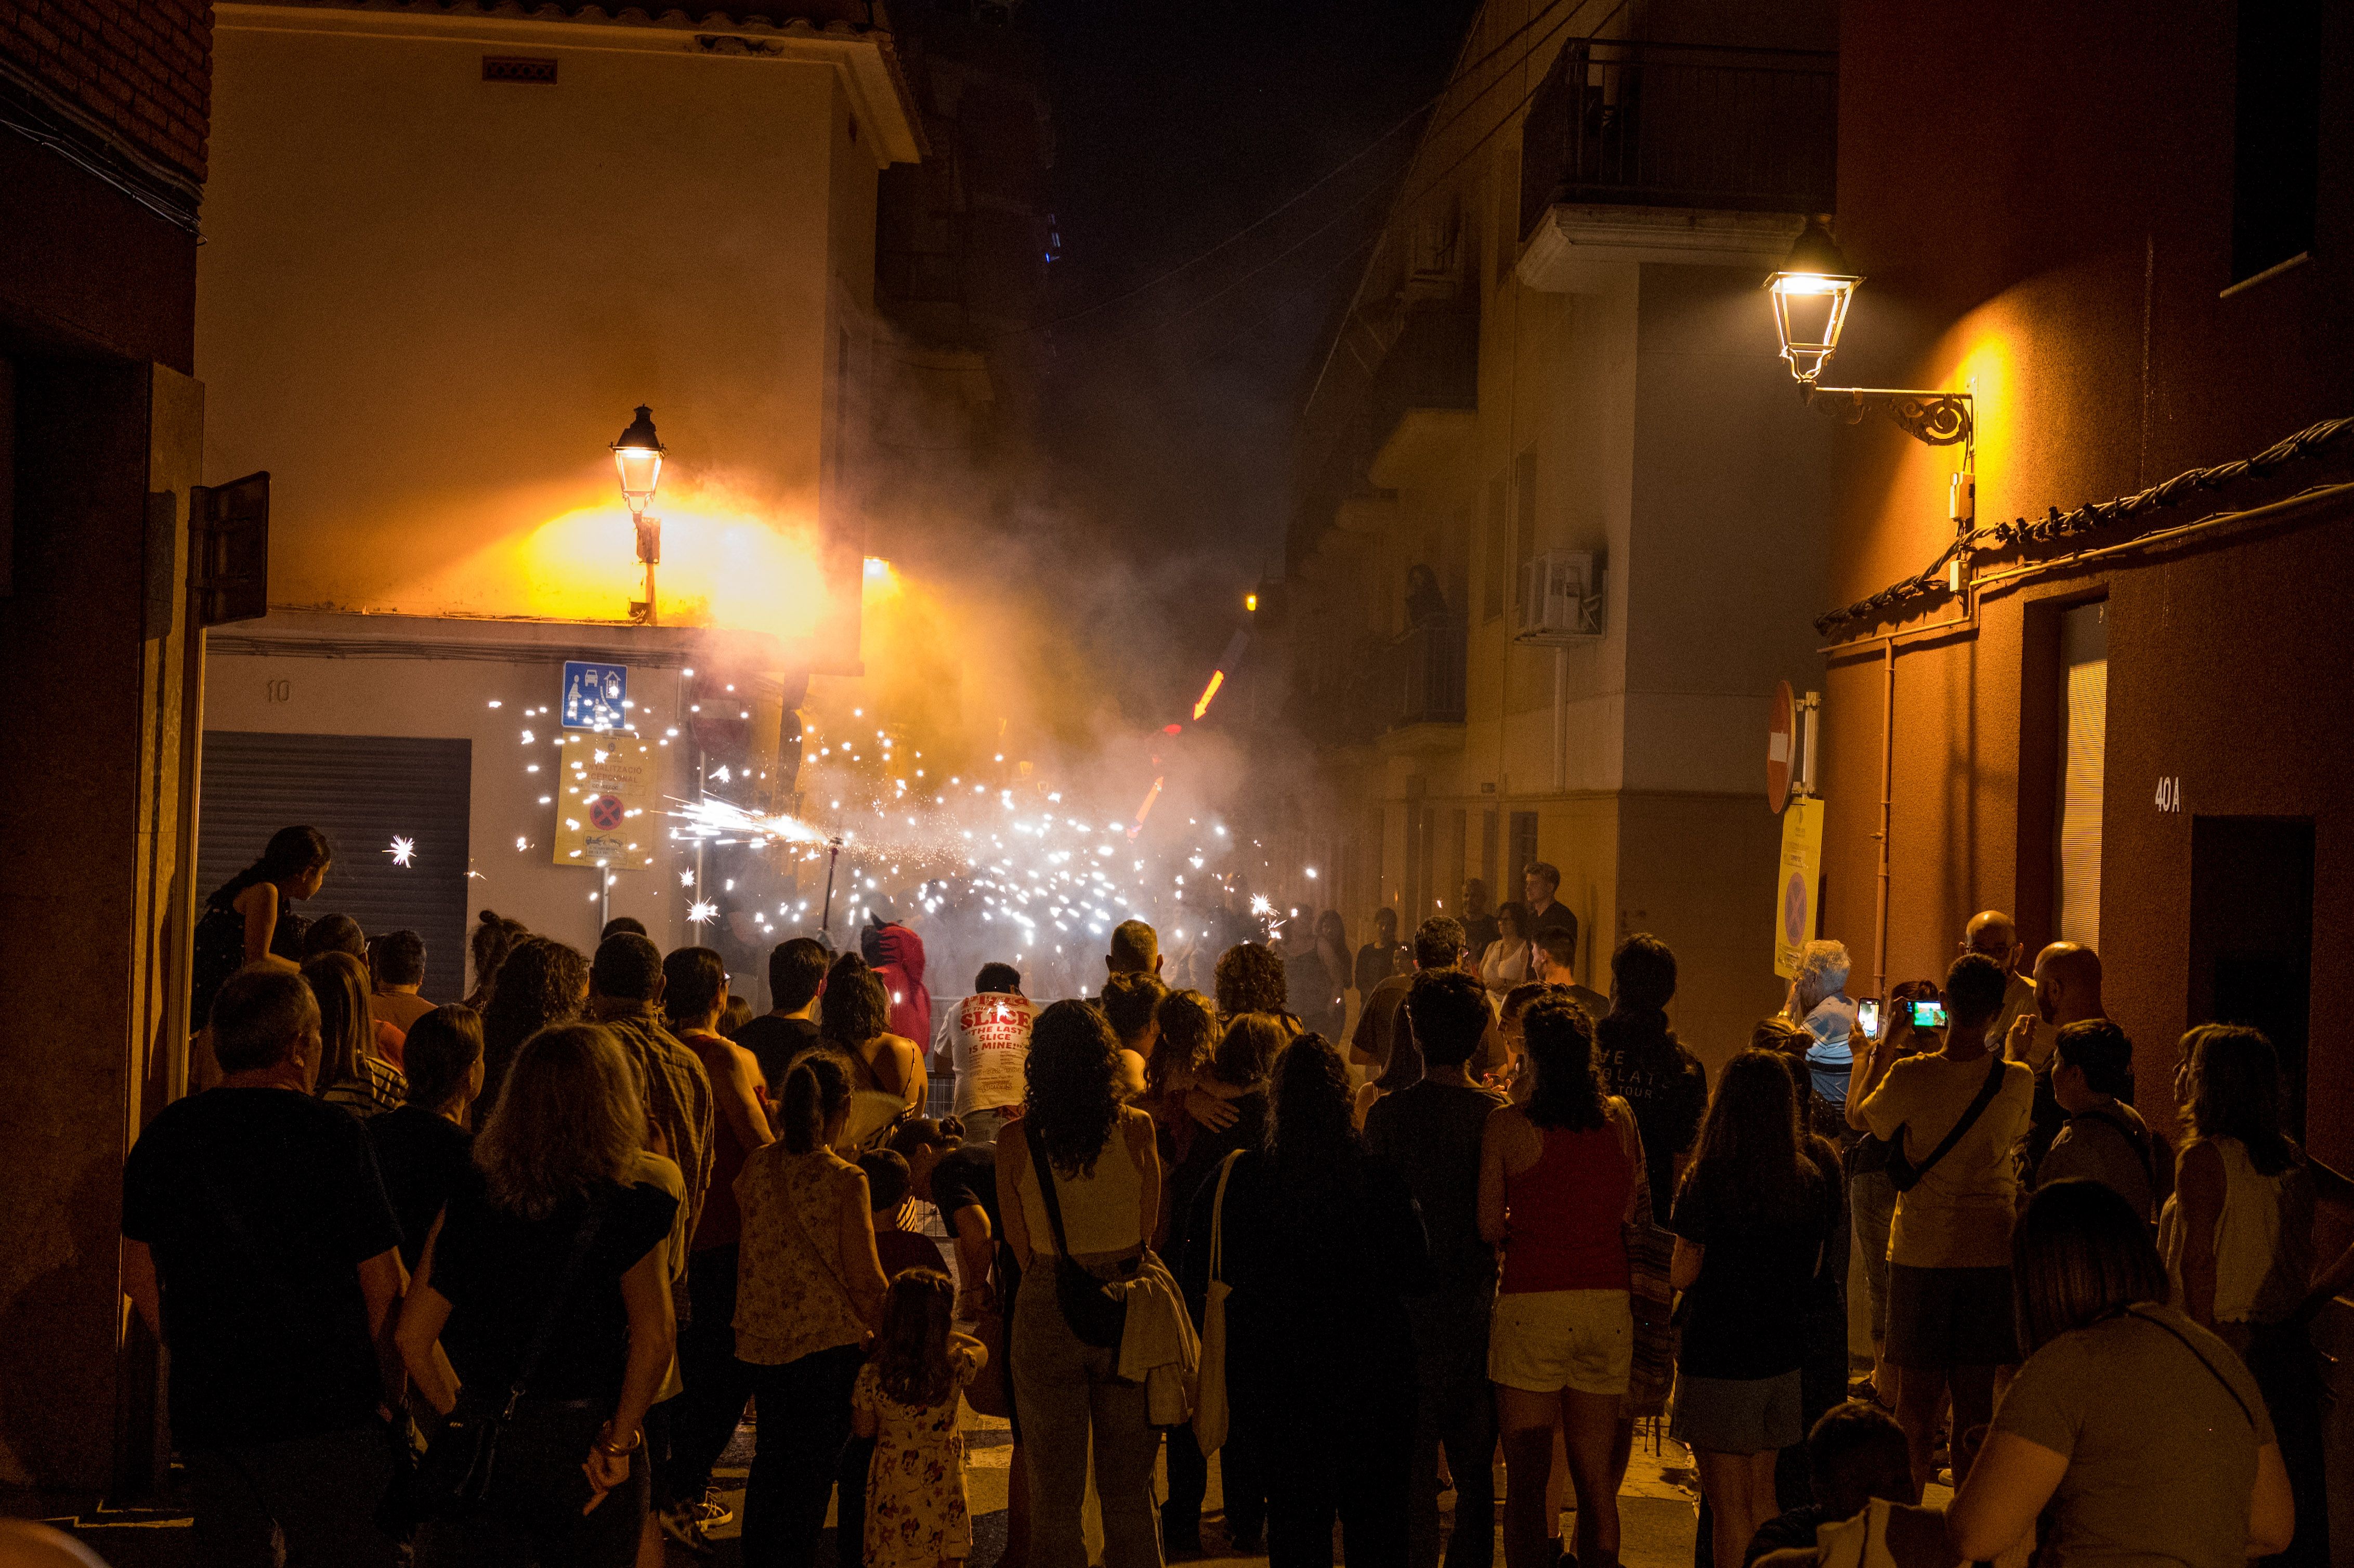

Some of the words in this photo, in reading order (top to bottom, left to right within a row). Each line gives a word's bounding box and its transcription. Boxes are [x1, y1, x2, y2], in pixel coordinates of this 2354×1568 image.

[268, 680, 289, 702] 10
[2155, 776, 2180, 812] 40A
[960, 1010, 1031, 1031] SLICE
[979, 1034, 1011, 1042] SLICE
[997, 1026, 1023, 1035] LAST
[969, 1045, 978, 1054] IS
